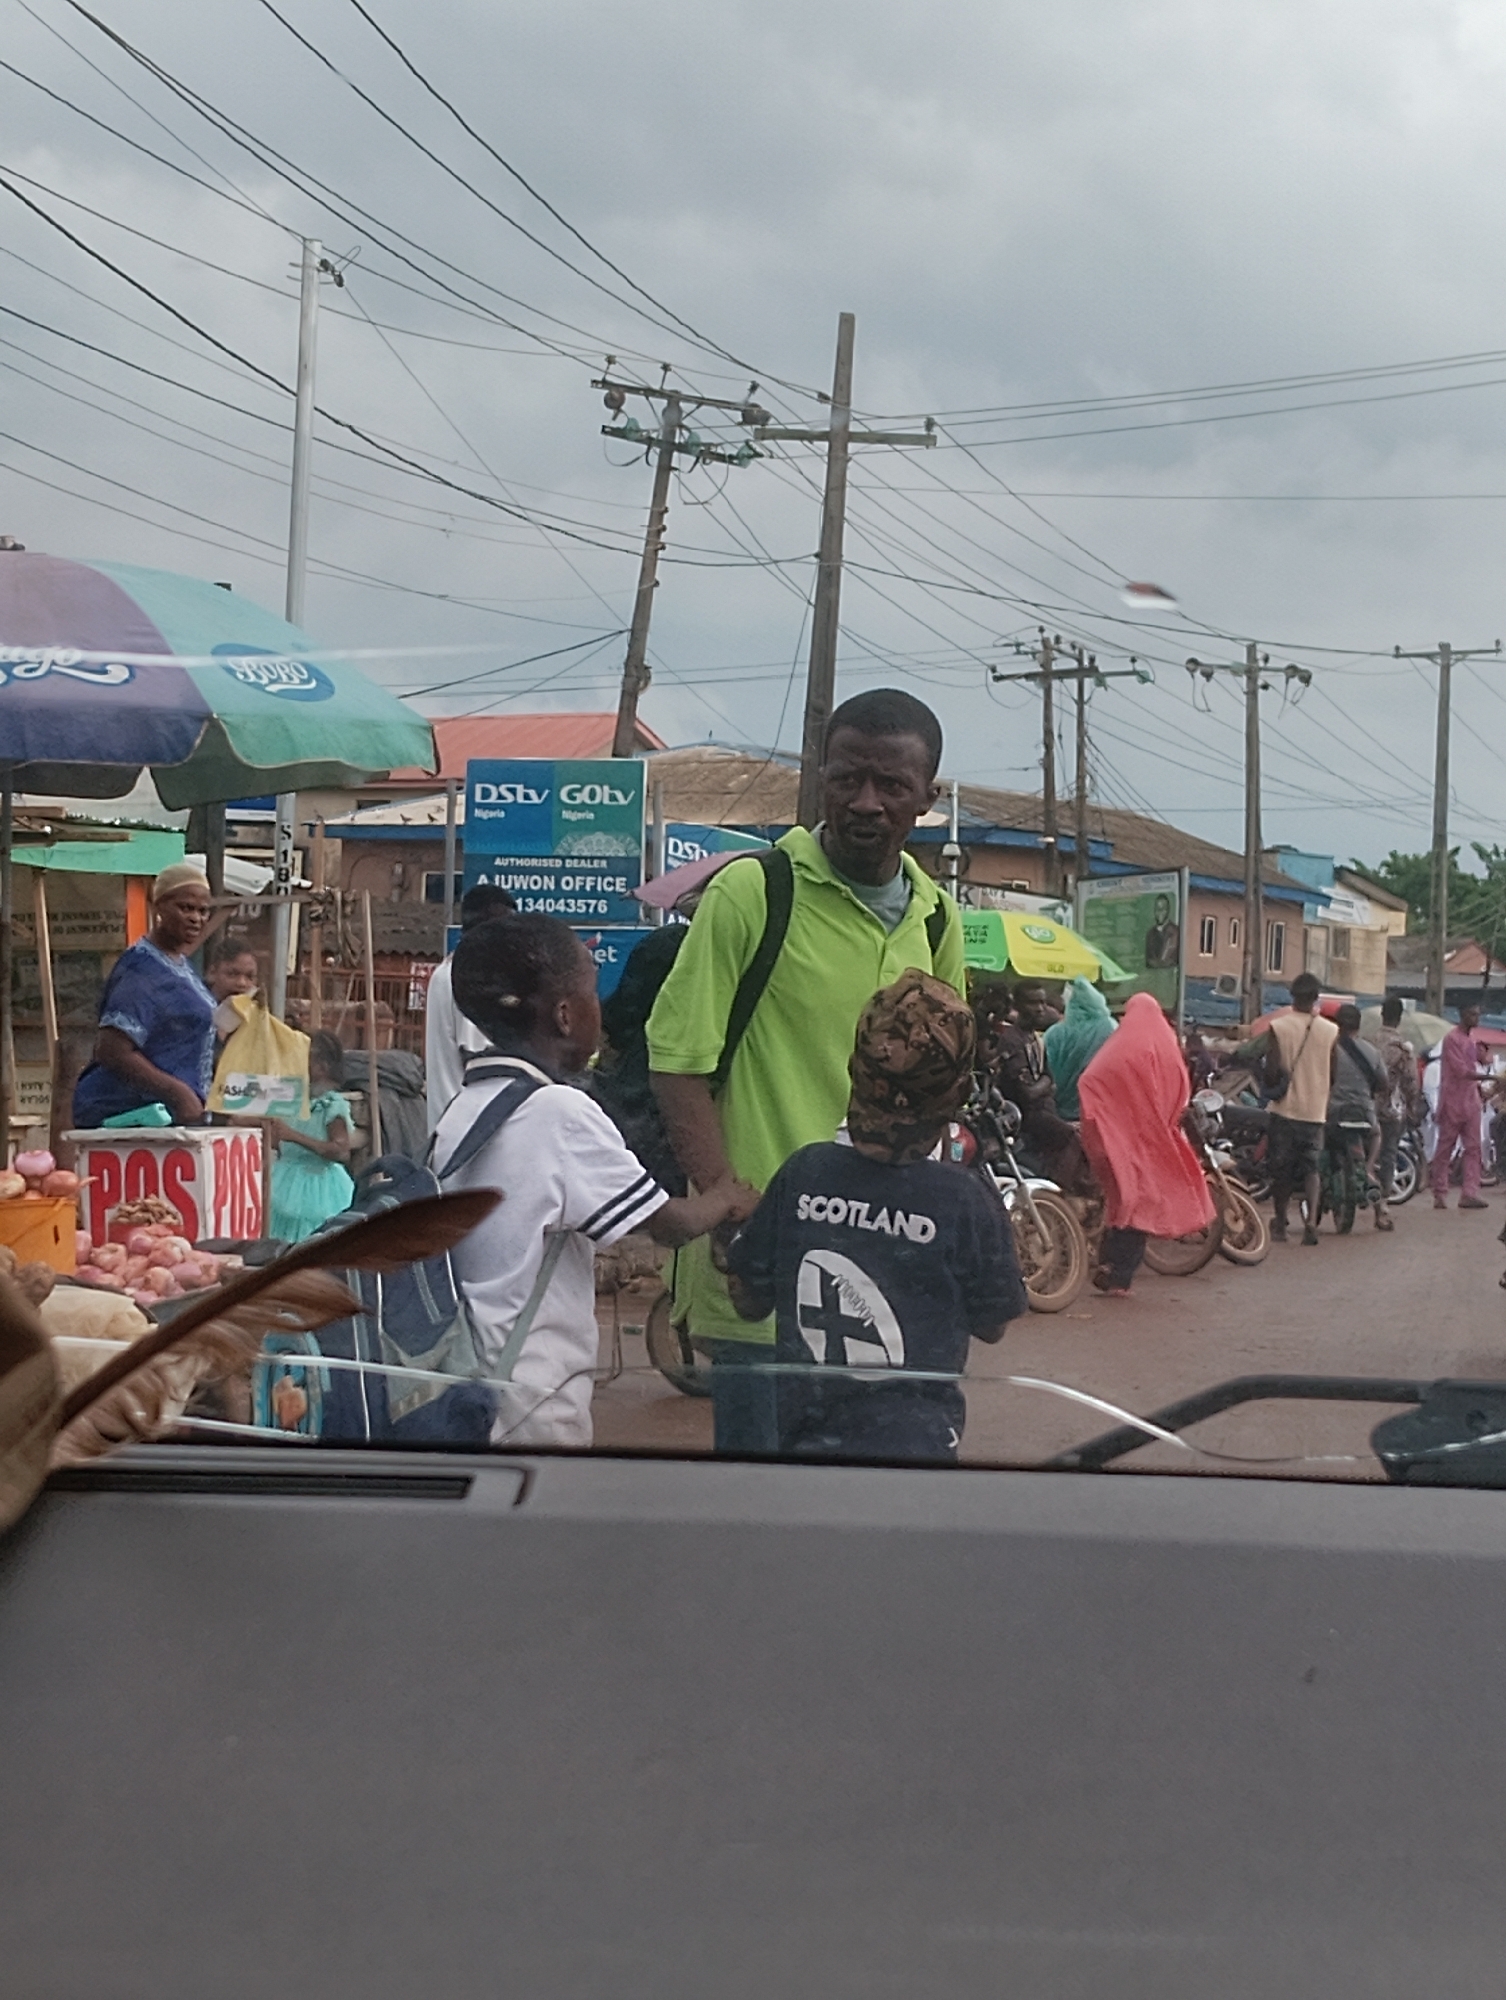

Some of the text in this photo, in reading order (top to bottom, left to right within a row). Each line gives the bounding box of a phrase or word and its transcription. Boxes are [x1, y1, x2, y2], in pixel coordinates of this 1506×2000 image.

[474, 783, 635, 805] DStv GOtv
[474, 808, 594, 821] Nigeria Nigeria
[494, 857, 608, 869] AUTHORISED DEALER
[561, 876, 628, 892] OFFICE
[88, 1147, 199, 1247] POS
[212, 1134, 262, 1240] POS
[797, 1194, 937, 1244] SCOTLAND
